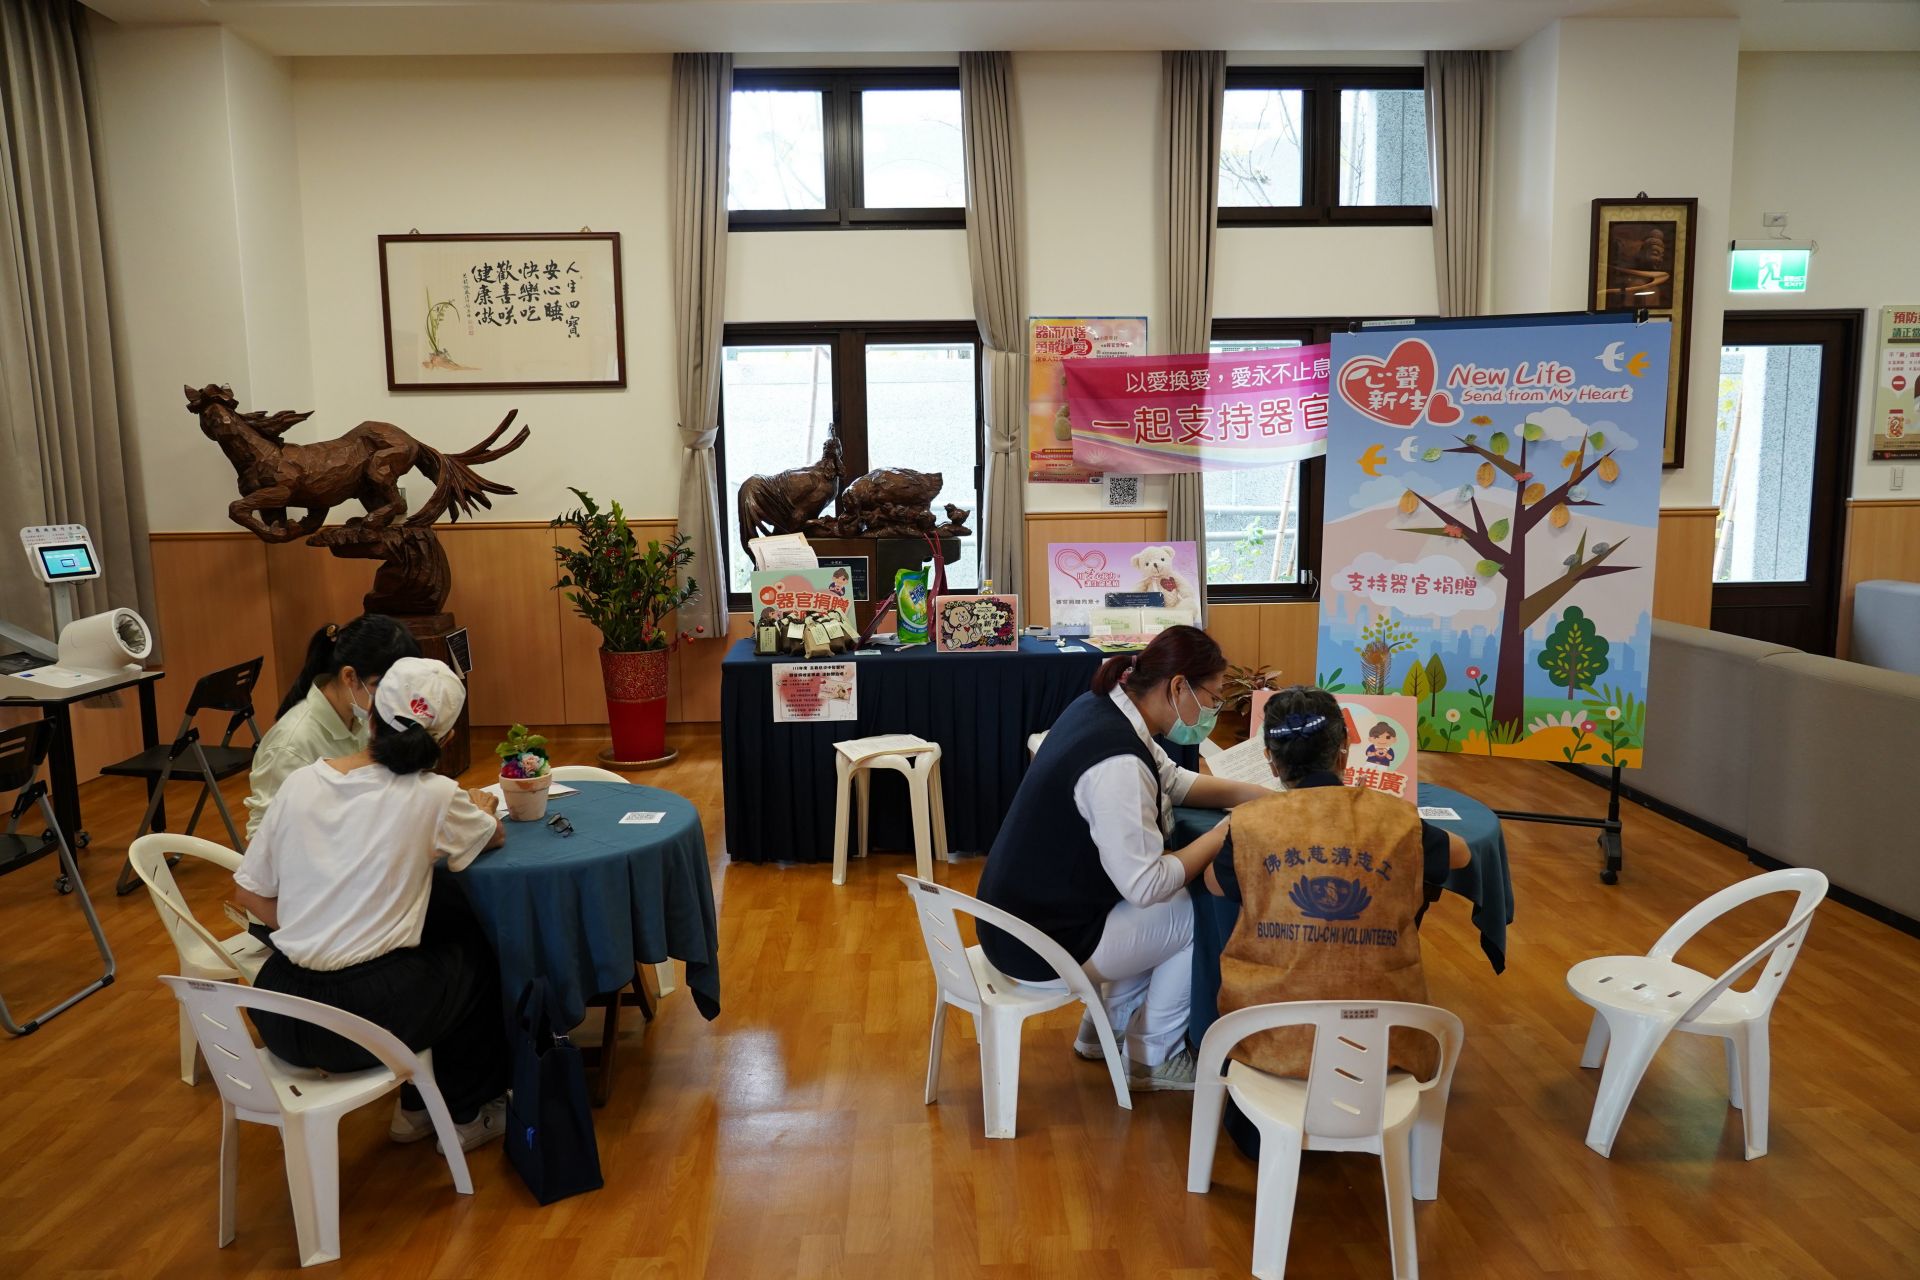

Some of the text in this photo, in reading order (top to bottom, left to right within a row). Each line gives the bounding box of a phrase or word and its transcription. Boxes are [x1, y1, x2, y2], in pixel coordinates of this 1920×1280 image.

[471, 262, 502, 327] 健康做
[518, 260, 541, 322] 快樂吃
[543, 259, 564, 322] 安心睡
[566, 261, 580, 338] 人生四寶
[1893, 312, 1920, 324] 預防
[1126, 358, 1331, 393] 以愛換愛，愛永不止息
[1347, 366, 1421, 389] 心聲
[1449, 363, 1573, 387] New Life
[1368, 390, 1427, 411] 新生
[1463, 387, 1630, 402] Send from My Heart
[1092, 392, 1329, 445] 一起支持器官
[1347, 572, 1477, 596] 支持器官捐贈
[776, 592, 849, 613] 器官捐贈
[1263, 845, 1393, 881] 佛教慈濟志工
[1257, 922, 1397, 946] BUDDHIST TZU-CHI VOLUNTEERS
